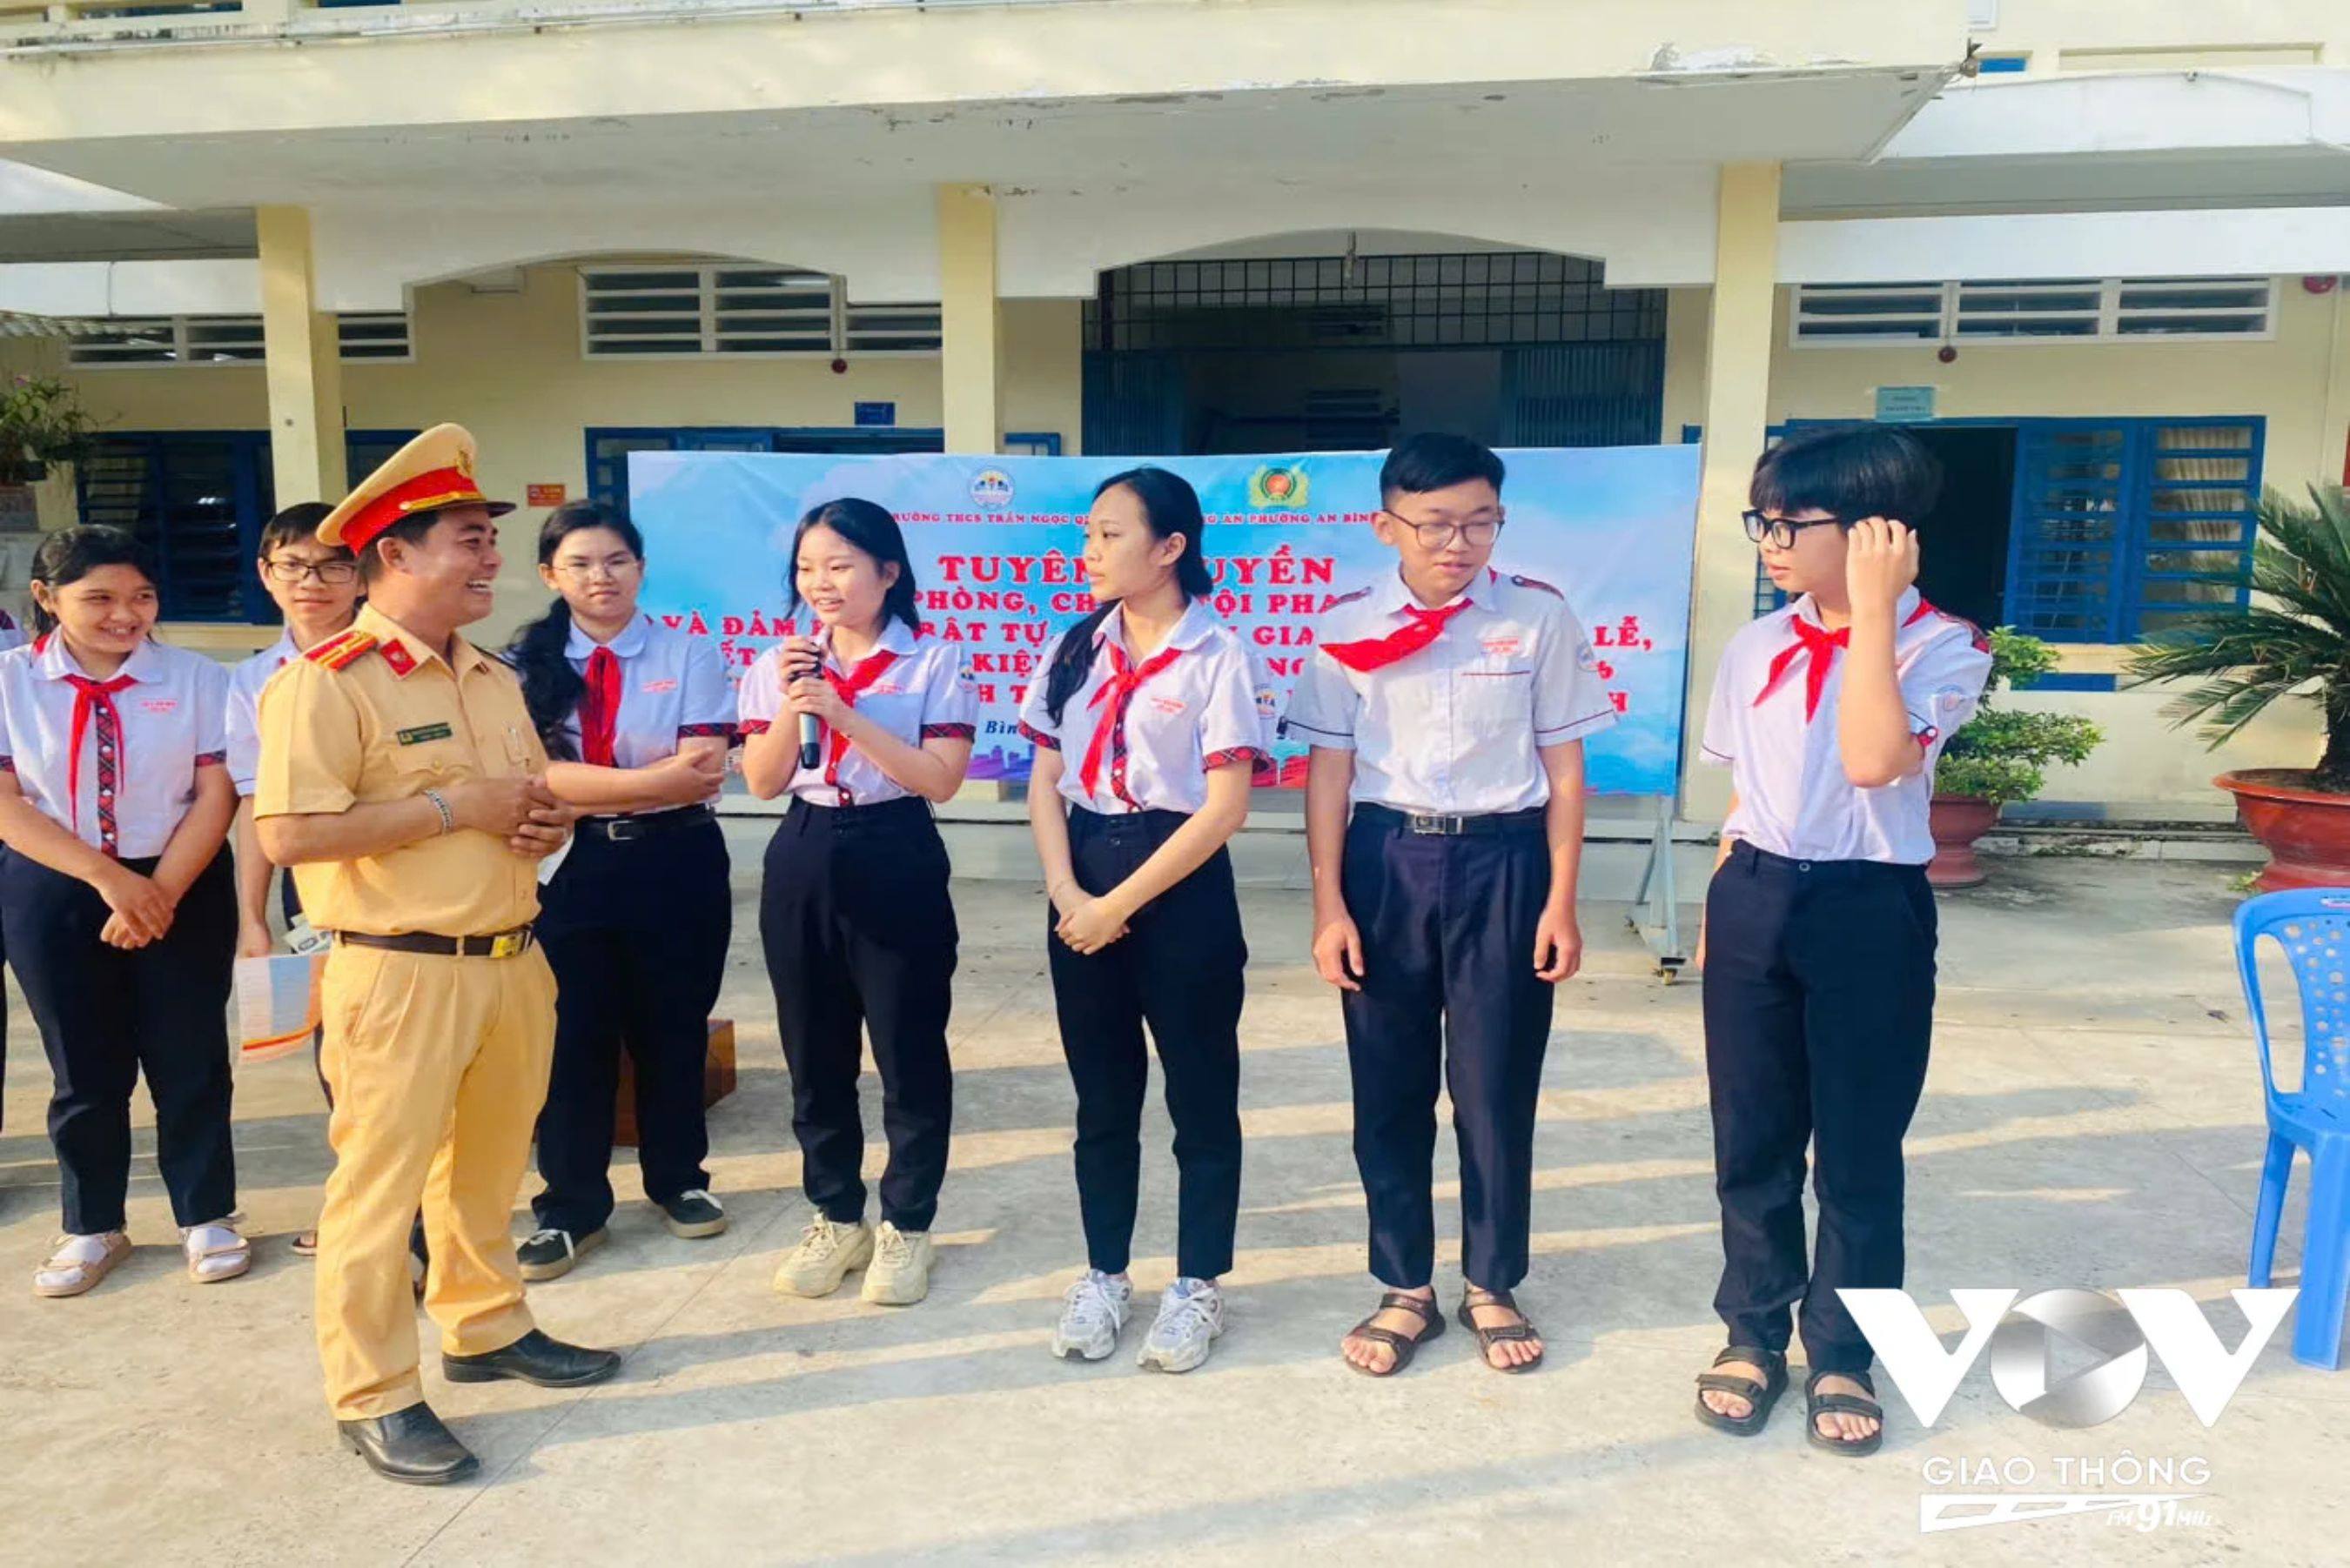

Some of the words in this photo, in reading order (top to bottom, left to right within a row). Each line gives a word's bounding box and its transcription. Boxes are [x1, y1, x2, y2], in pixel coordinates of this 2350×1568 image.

[892, 510, 940, 523] RƯỜNG
[947, 513, 982, 523] THCS
[1031, 513, 1069, 525] NGỌC
[1224, 514, 1243, 524] AN
[1316, 513, 1338, 524] AN
[1343, 512, 1373, 523] BÌN
[1203, 543, 1335, 584] UYỀN
[722, 609, 796, 637] ĐẢM
[1594, 615, 1652, 651] LỄ,
[972, 648, 1043, 678] KIỆ
[985, 720, 1018, 734] Bìn
